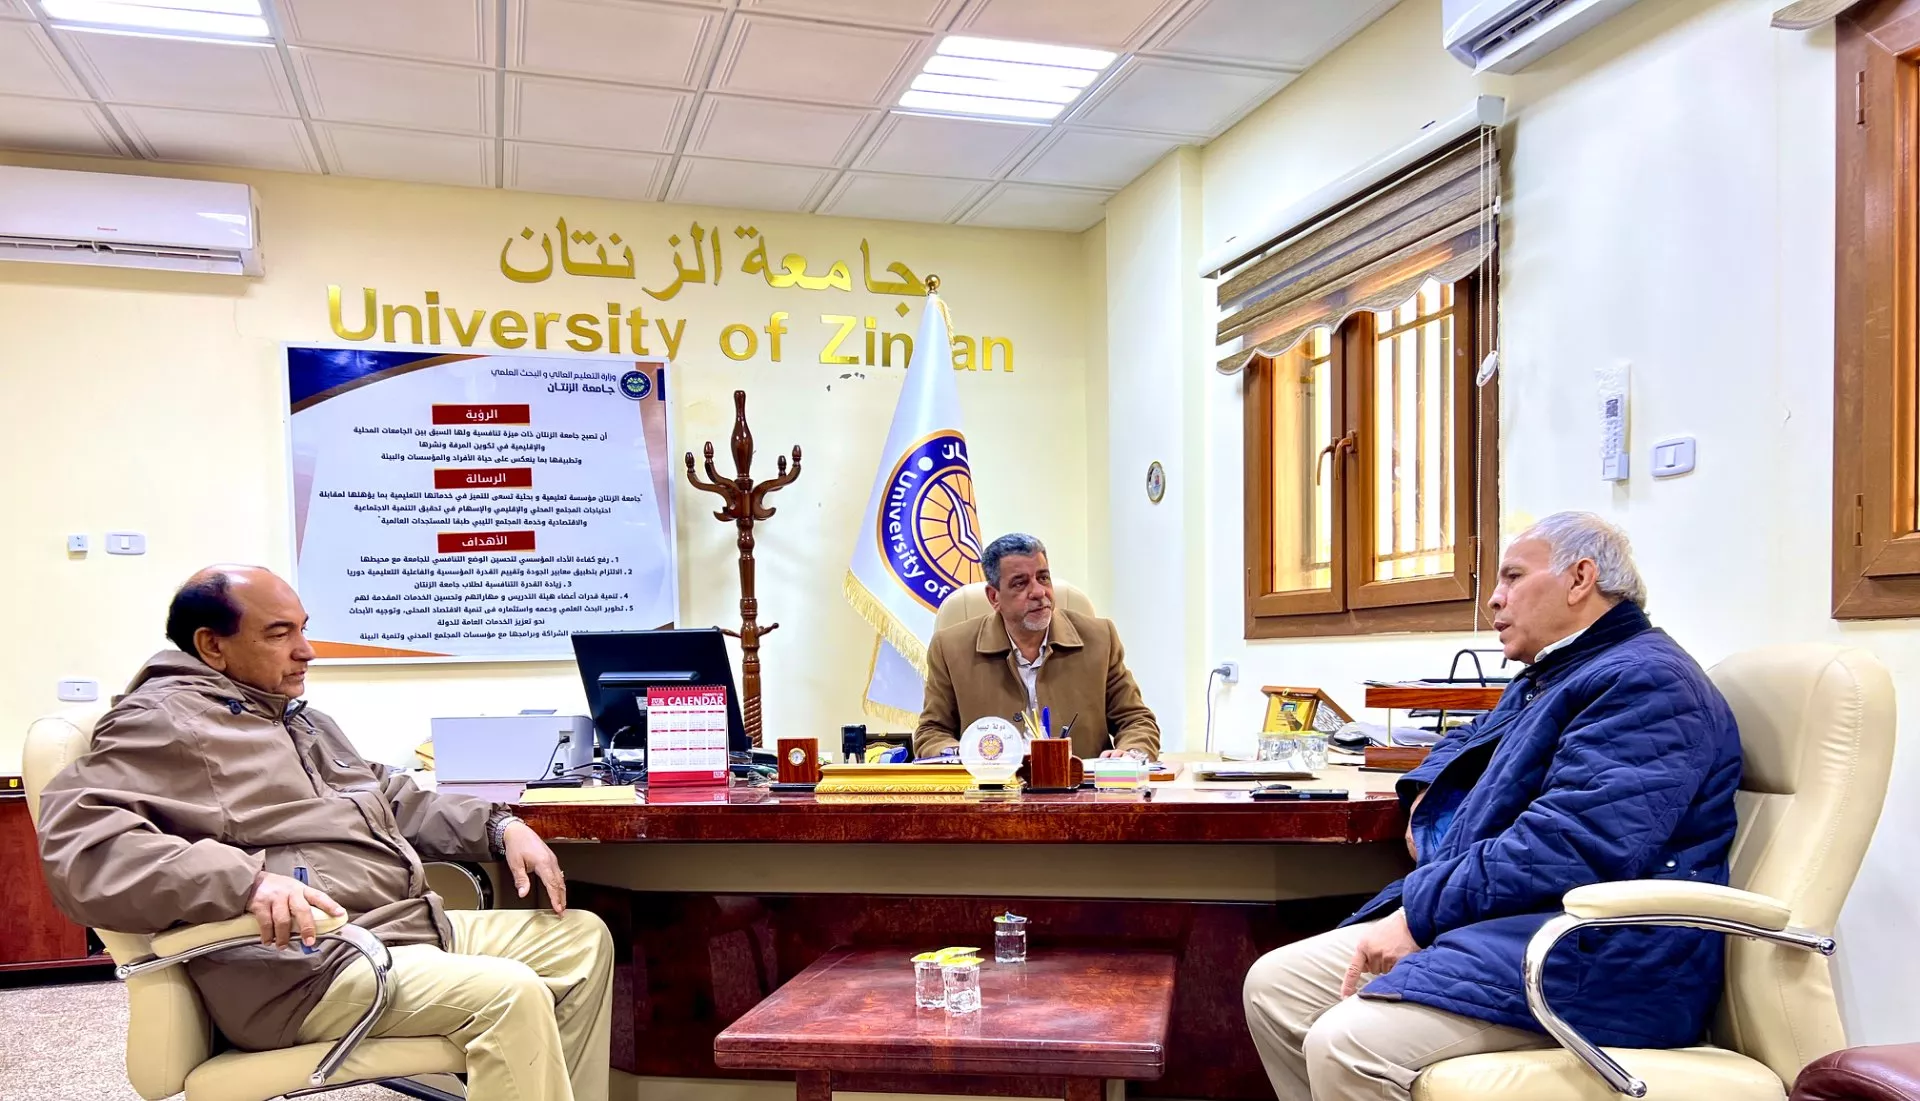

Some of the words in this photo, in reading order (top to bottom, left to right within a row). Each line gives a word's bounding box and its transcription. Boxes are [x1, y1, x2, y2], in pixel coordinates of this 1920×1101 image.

[501, 217, 722, 300] الزنتان
[740, 226, 927, 317] جامعة
[327, 285, 687, 360] University
[720, 312, 788, 364] of
[818, 314, 1014, 372] Zinan
[491, 369, 519, 377] العلمي
[549, 371, 573, 379] العالي
[574, 372, 600, 380] التعليم
[601, 373, 617, 382] وزارة
[548, 382, 579, 394] الزنتان
[583, 384, 615, 394] جامعة
[465, 409, 498, 421] الرؤية
[354, 426, 380, 435] المحلية
[382, 427, 413, 436] الجامعات
[415, 428, 427, 437] بين
[429, 428, 452, 437] السبق
[454, 428, 471, 438] ولها
[473, 429, 501, 438] تنافسية
[503, 430, 519, 439] ميزة
[521, 430, 534, 438] ذات
[560, 431, 580, 439] جامعة
[536, 431, 558, 440] الزنتان
[582, 433, 598, 442] تصبح
[419, 440, 447, 450] ونشرها
[474, 442, 495, 451] تكوين
[497, 443, 509, 453] في
[408, 453, 451, 463] والمؤسسات
[453, 453, 476, 463] الأفراد
[477, 454, 493, 464] حياة
[494, 455, 509, 464] على
[511, 455, 536, 465] ينعكس
[537, 456, 548, 464] بما
[550, 456, 583, 466] وتطبيقها
[466, 473, 506, 485] الرسالة
[319, 490, 346, 499] لمقابلة
[378, 491, 388, 500] بما
[390, 491, 422, 501] التعليمية
[425, 491, 453, 499] خدماتها
[455, 492, 468, 503] في
[469, 492, 490, 501] للتميز
[492, 493, 514, 502] تسعى
[516, 492, 534, 502] بحثية
[542, 493, 568, 503] تعليمية
[569, 494, 597, 503] مؤسسة
[598, 494, 620, 503] الزنتان
[354, 504, 390, 513] الاجتماعية
[392, 504, 417, 513] التنمية
[419, 505, 442, 513] تحقيق
[444, 505, 456, 515] في
[530, 506, 554, 516] المحلي
[556, 506, 582, 515] المجتمع
[584, 506, 611, 515] احتياجات
[412, 517, 451, 525] للمستجدات
[453, 517, 470, 525] طبقا
[495, 518, 522, 528] المجتمع
[524, 518, 546, 527] وخدمة
[548, 518, 588, 528] والاقتصادية
[888, 470, 925, 579] University
[924, 579, 951, 599] of
[462, 535, 508, 547] الأهداف
[361, 555, 390, 565] محيطها
[392, 557, 402, 565] مع
[404, 555, 430, 564] للجامعة
[432, 555, 466, 566] التنافسي
[468, 555, 489, 565] الوضع
[491, 555, 517, 564] لتحسين
[519, 555, 555, 566] المؤسسي
[576, 555, 596, 563] كفاءة
[598, 556, 610, 565] رفع
[347, 568, 366, 577] دوريا
[368, 568, 400, 577] التعليمية
[402, 568, 435, 577] والفاعلية
[437, 568, 474, 577] المؤسسية
[476, 568, 499, 577] القدرة
[501, 568, 525, 577] وتقييم
[527, 568, 549, 577] الجودة
[551, 568, 571, 577] معايير
[573, 568, 598, 577] بتطبيق
[414, 581, 437, 590] الزنتان
[462, 580, 483, 588] لطلاب
[486, 580, 519, 590] التنافسية
[521, 580, 543, 589] القدرة
[545, 580, 562, 589] زيادة
[354, 594, 370, 604] لهم
[404, 593, 432, 601] الخدمات
[434, 593, 463, 602] وتحسين
[465, 593, 499, 603] مهاراتهم
[508, 593, 537, 602] التدريس
[540, 592, 556, 602] هيئة
[578, 592, 599, 601] قدرات
[601, 592, 619, 601] تنمية
[376, 607, 401, 616] وتوجيه
[433, 606, 461, 614] الاقتصاد
[464, 606, 483, 615] تنمية
[559, 605, 583, 615] العلمي
[584, 605, 603, 613] البحث
[604, 605, 625, 614] تطوير
[438, 618, 460, 628] للدولة
[462, 618, 483, 626] العامة
[486, 618, 513, 626] الخدمات
[534, 618, 545, 627] نحو
[382, 632, 405, 641] وتنمية
[407, 631, 432, 643] المدني
[434, 631, 461, 641] المجتمع
[464, 631, 497, 640] مؤسسات
[667, 696, 724, 706] CALENDAR
